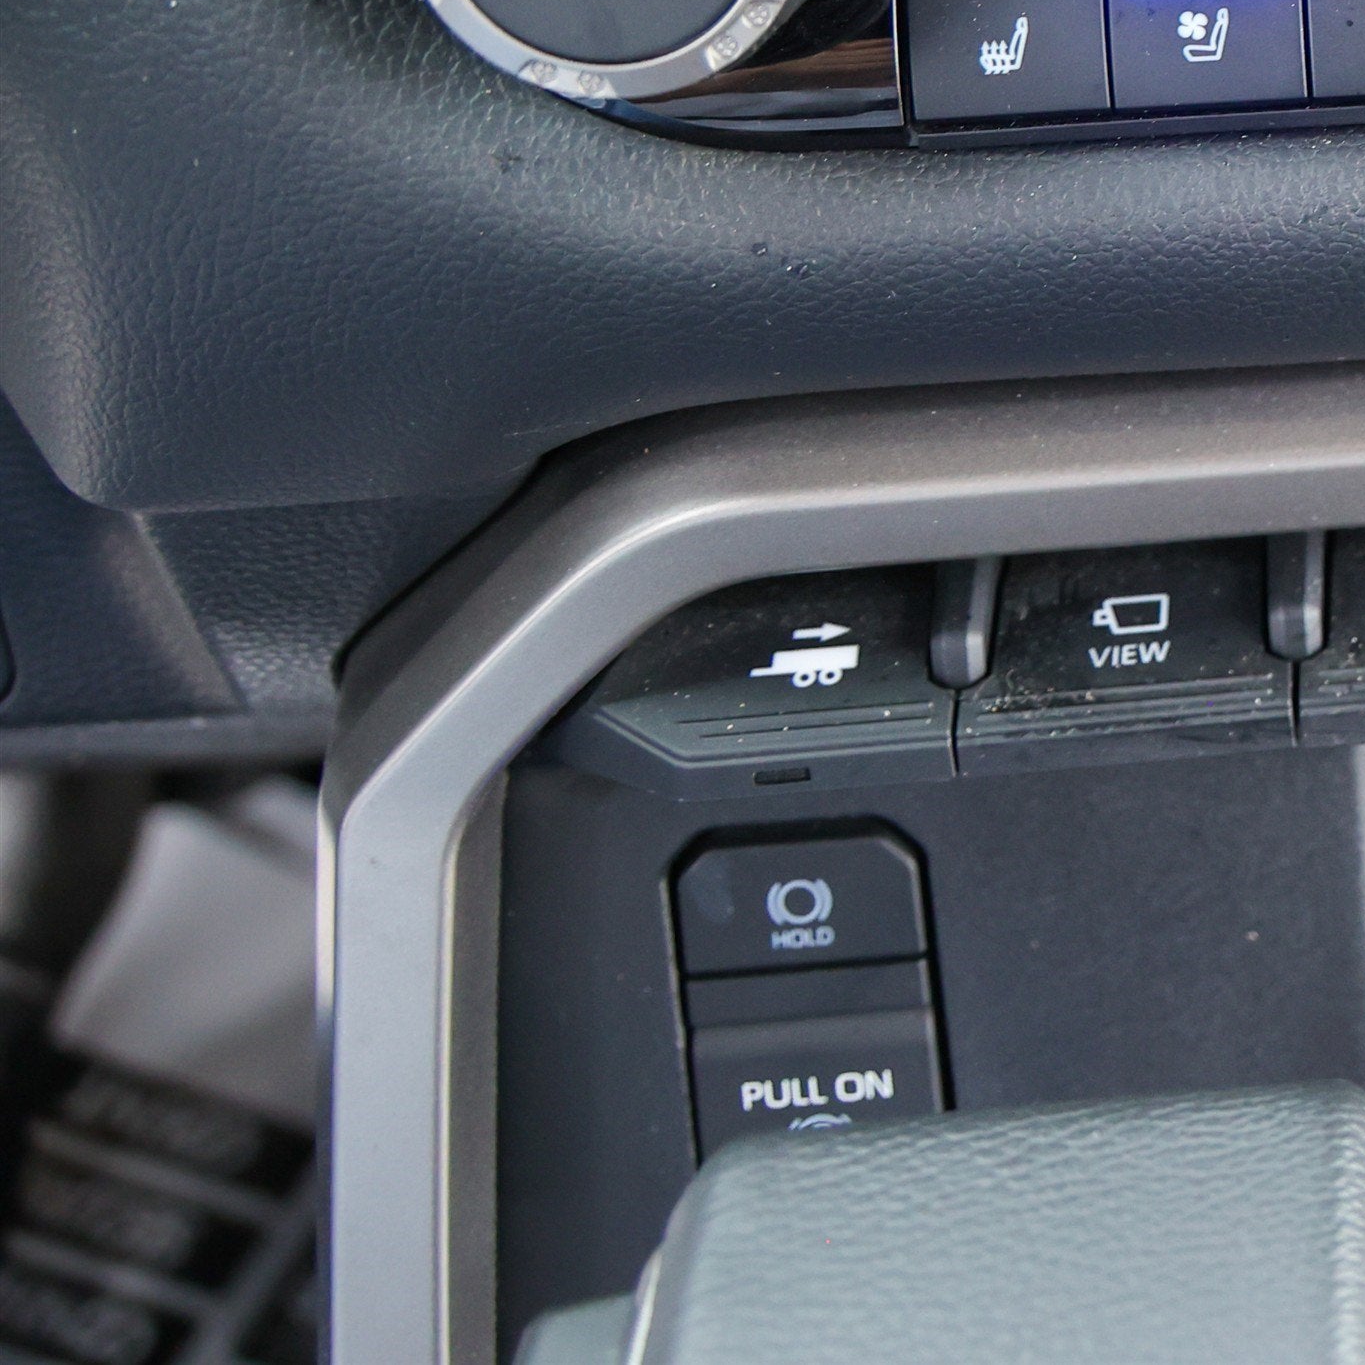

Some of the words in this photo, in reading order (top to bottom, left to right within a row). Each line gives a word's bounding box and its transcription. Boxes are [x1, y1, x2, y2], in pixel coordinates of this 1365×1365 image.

[1088, 639, 1172, 669] VIEW
[770, 925, 836, 950] HOLD
[740, 1076, 829, 1112] PULL
[834, 1069, 894, 1103] ON
